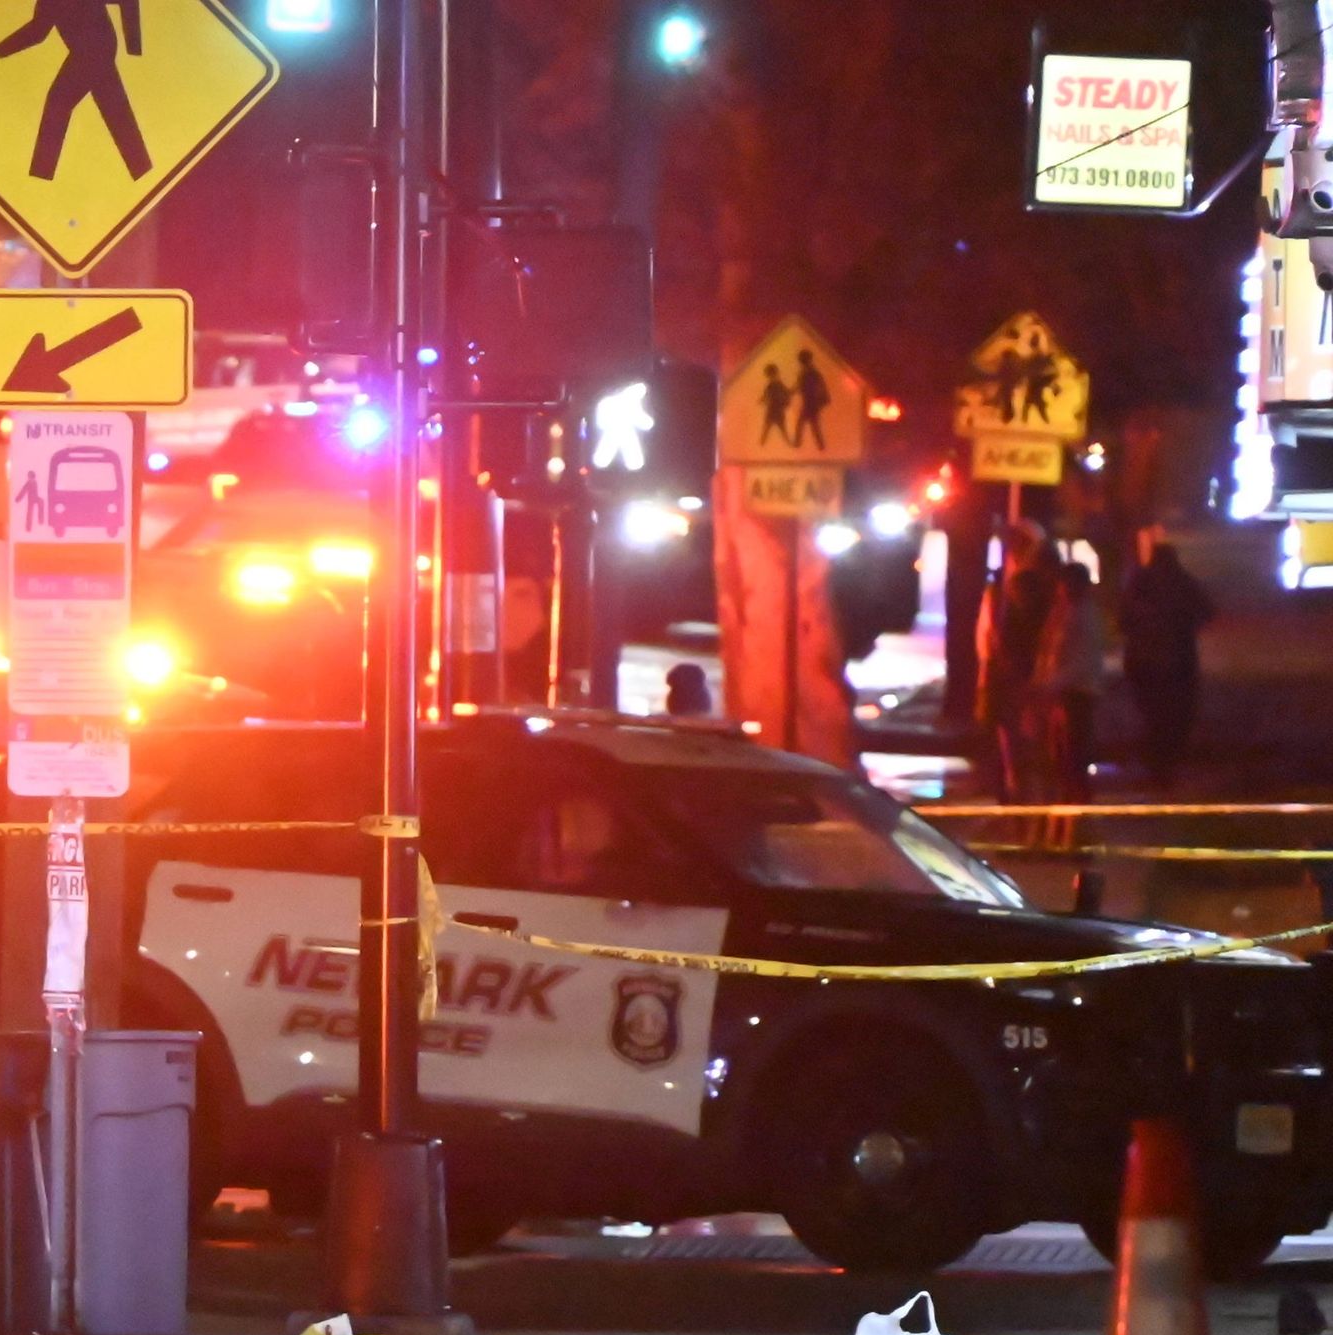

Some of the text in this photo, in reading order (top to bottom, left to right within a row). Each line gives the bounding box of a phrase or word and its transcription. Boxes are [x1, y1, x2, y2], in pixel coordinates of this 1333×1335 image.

[1054, 75, 1179, 111] STEADY
[1047, 122, 1111, 146] NAILS
[1140, 126, 1182, 148] SPA
[43, 422, 114, 439] TRANSIT
[245, 935, 579, 1021] NEARK
[281, 1004, 492, 1058] POCE
[1003, 1024, 1049, 1050] 515
